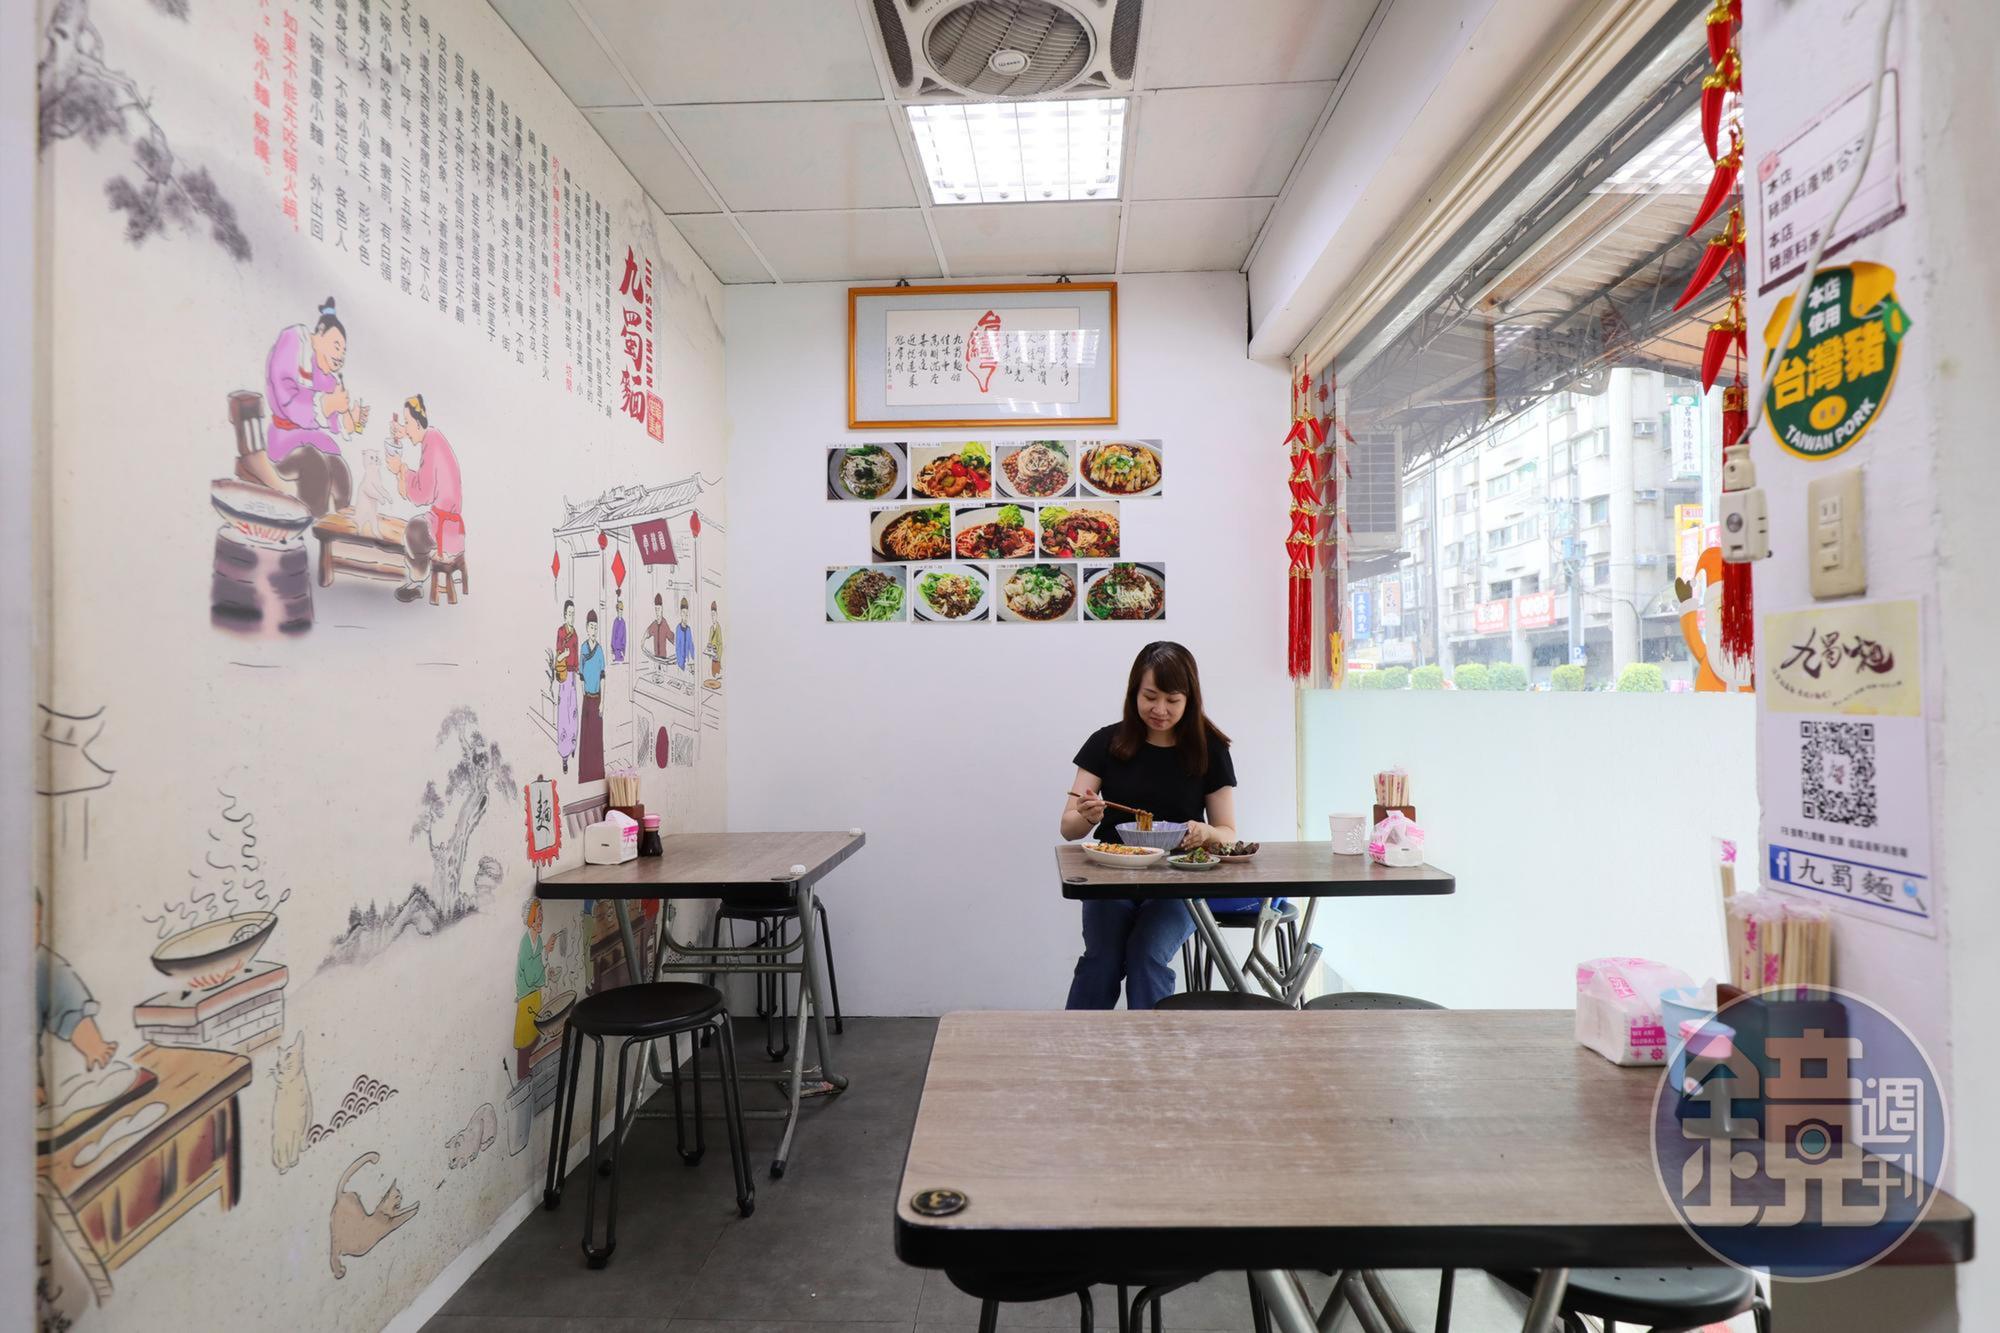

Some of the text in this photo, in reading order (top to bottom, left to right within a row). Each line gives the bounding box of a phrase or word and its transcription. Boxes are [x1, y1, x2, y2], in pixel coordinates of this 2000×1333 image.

[1808, 277, 1841, 309] 本店
[1808, 304, 1841, 338] 使用
[1772, 320, 1887, 411] 台灣豬
[1784, 397, 1876, 452] TAIWAN PORK
[1797, 859, 1895, 903] 九蜀麵
